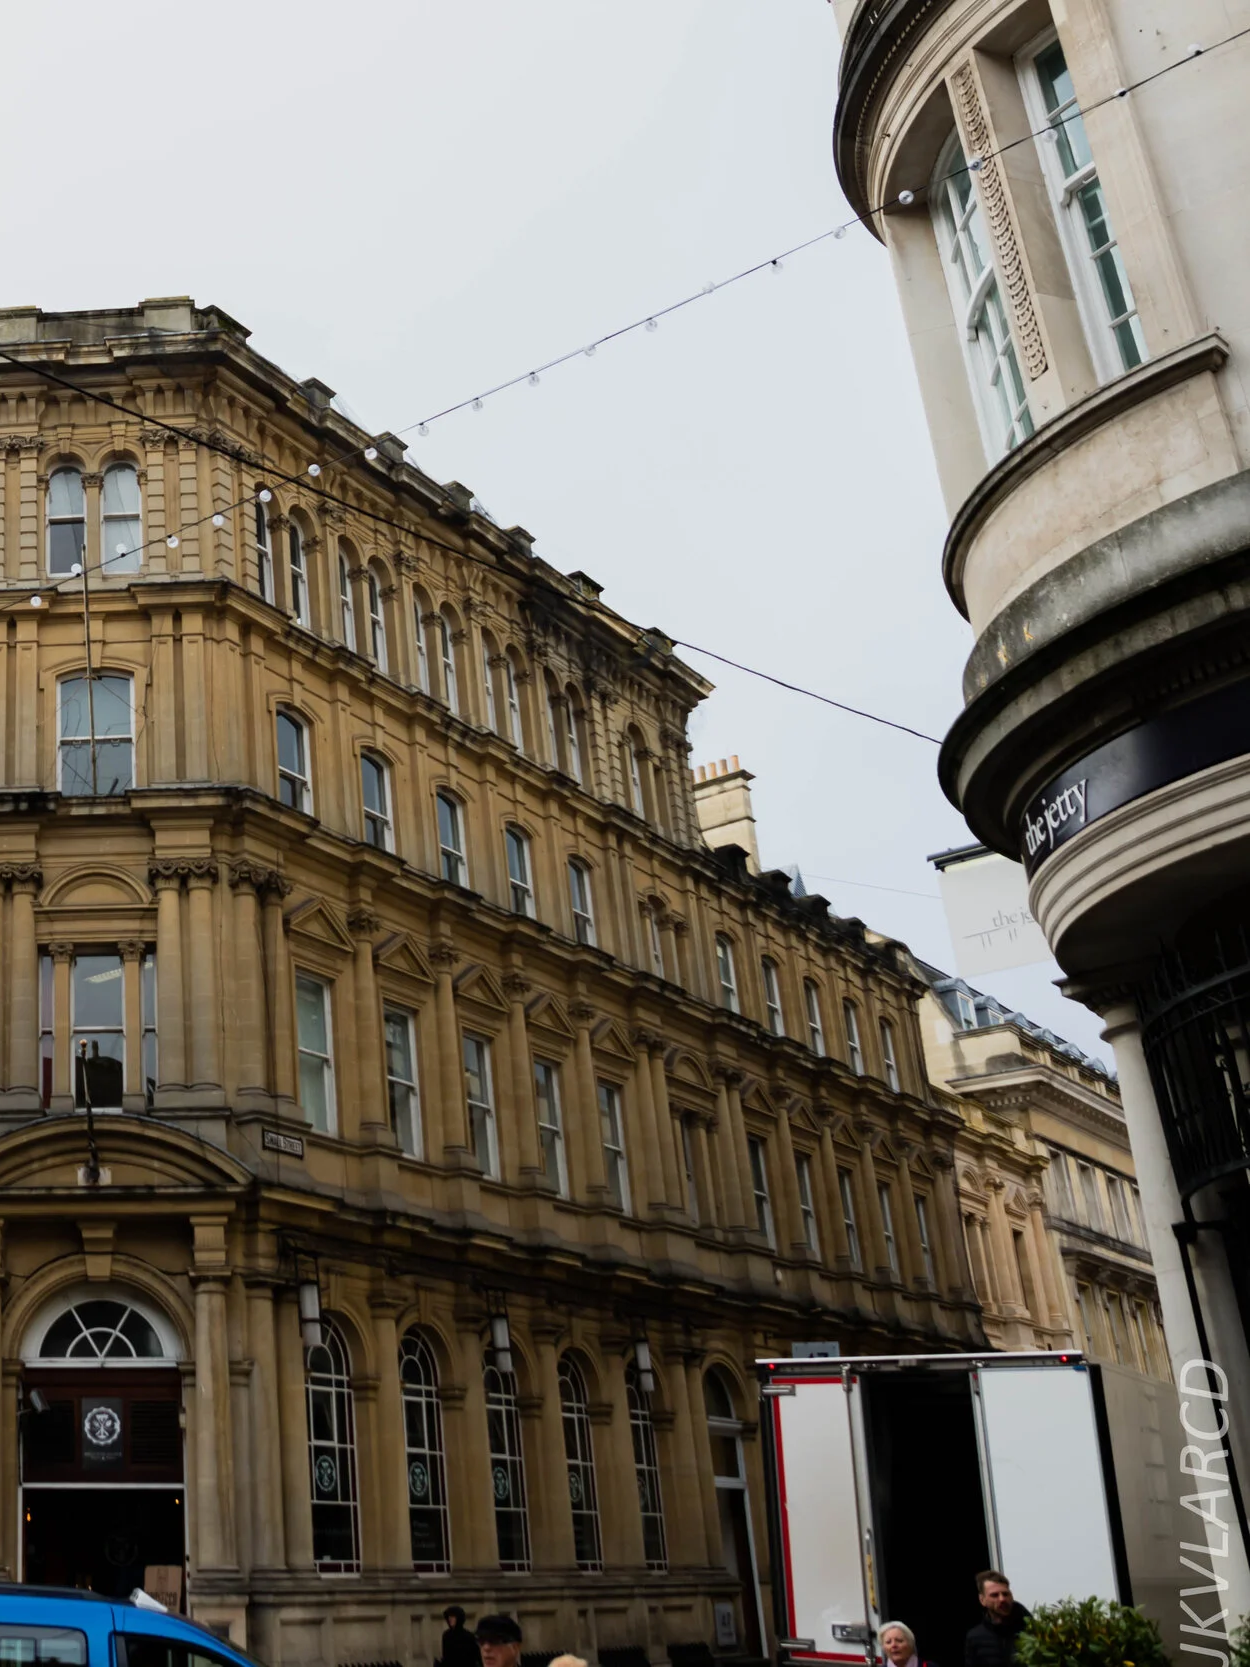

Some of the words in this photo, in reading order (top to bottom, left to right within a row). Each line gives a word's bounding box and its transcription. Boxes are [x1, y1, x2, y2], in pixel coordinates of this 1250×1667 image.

[1025, 812, 1047, 856] the
[1042, 778, 1086, 850] jetty
[992, 909, 1018, 928] the
